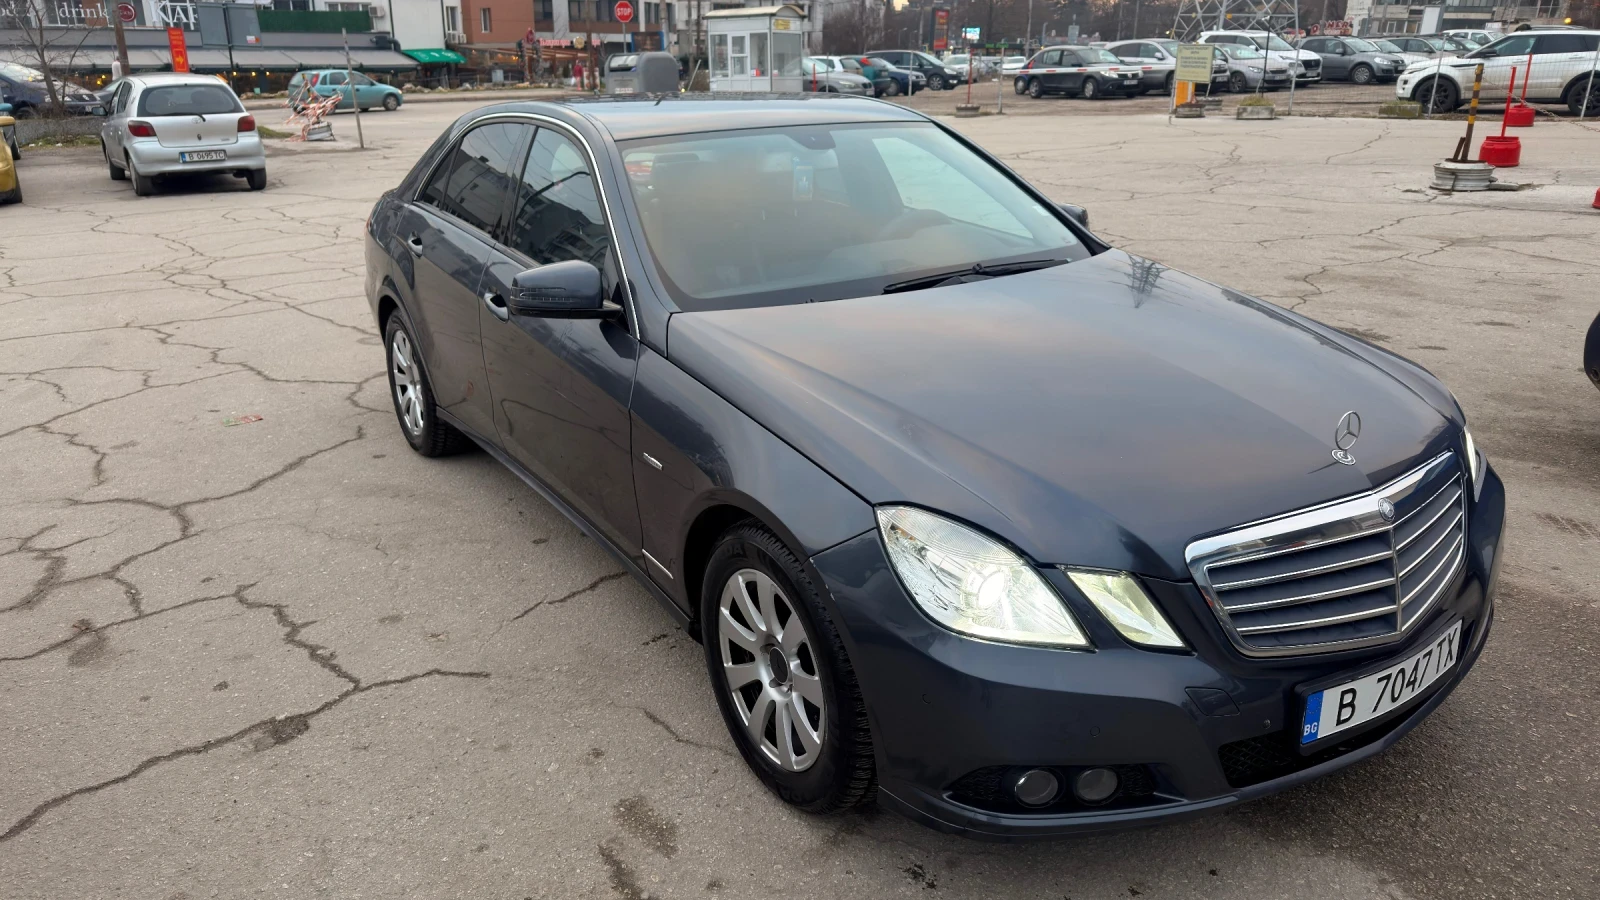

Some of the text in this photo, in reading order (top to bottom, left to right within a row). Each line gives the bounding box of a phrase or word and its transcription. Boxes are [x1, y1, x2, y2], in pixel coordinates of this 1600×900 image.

[59, 2, 109, 18] drink
[617, 8, 632, 16] STOP
[188, 153, 194, 161] B
[1335, 627, 1458, 726] B 7047 TX
[1303, 722, 1318, 736] BG
